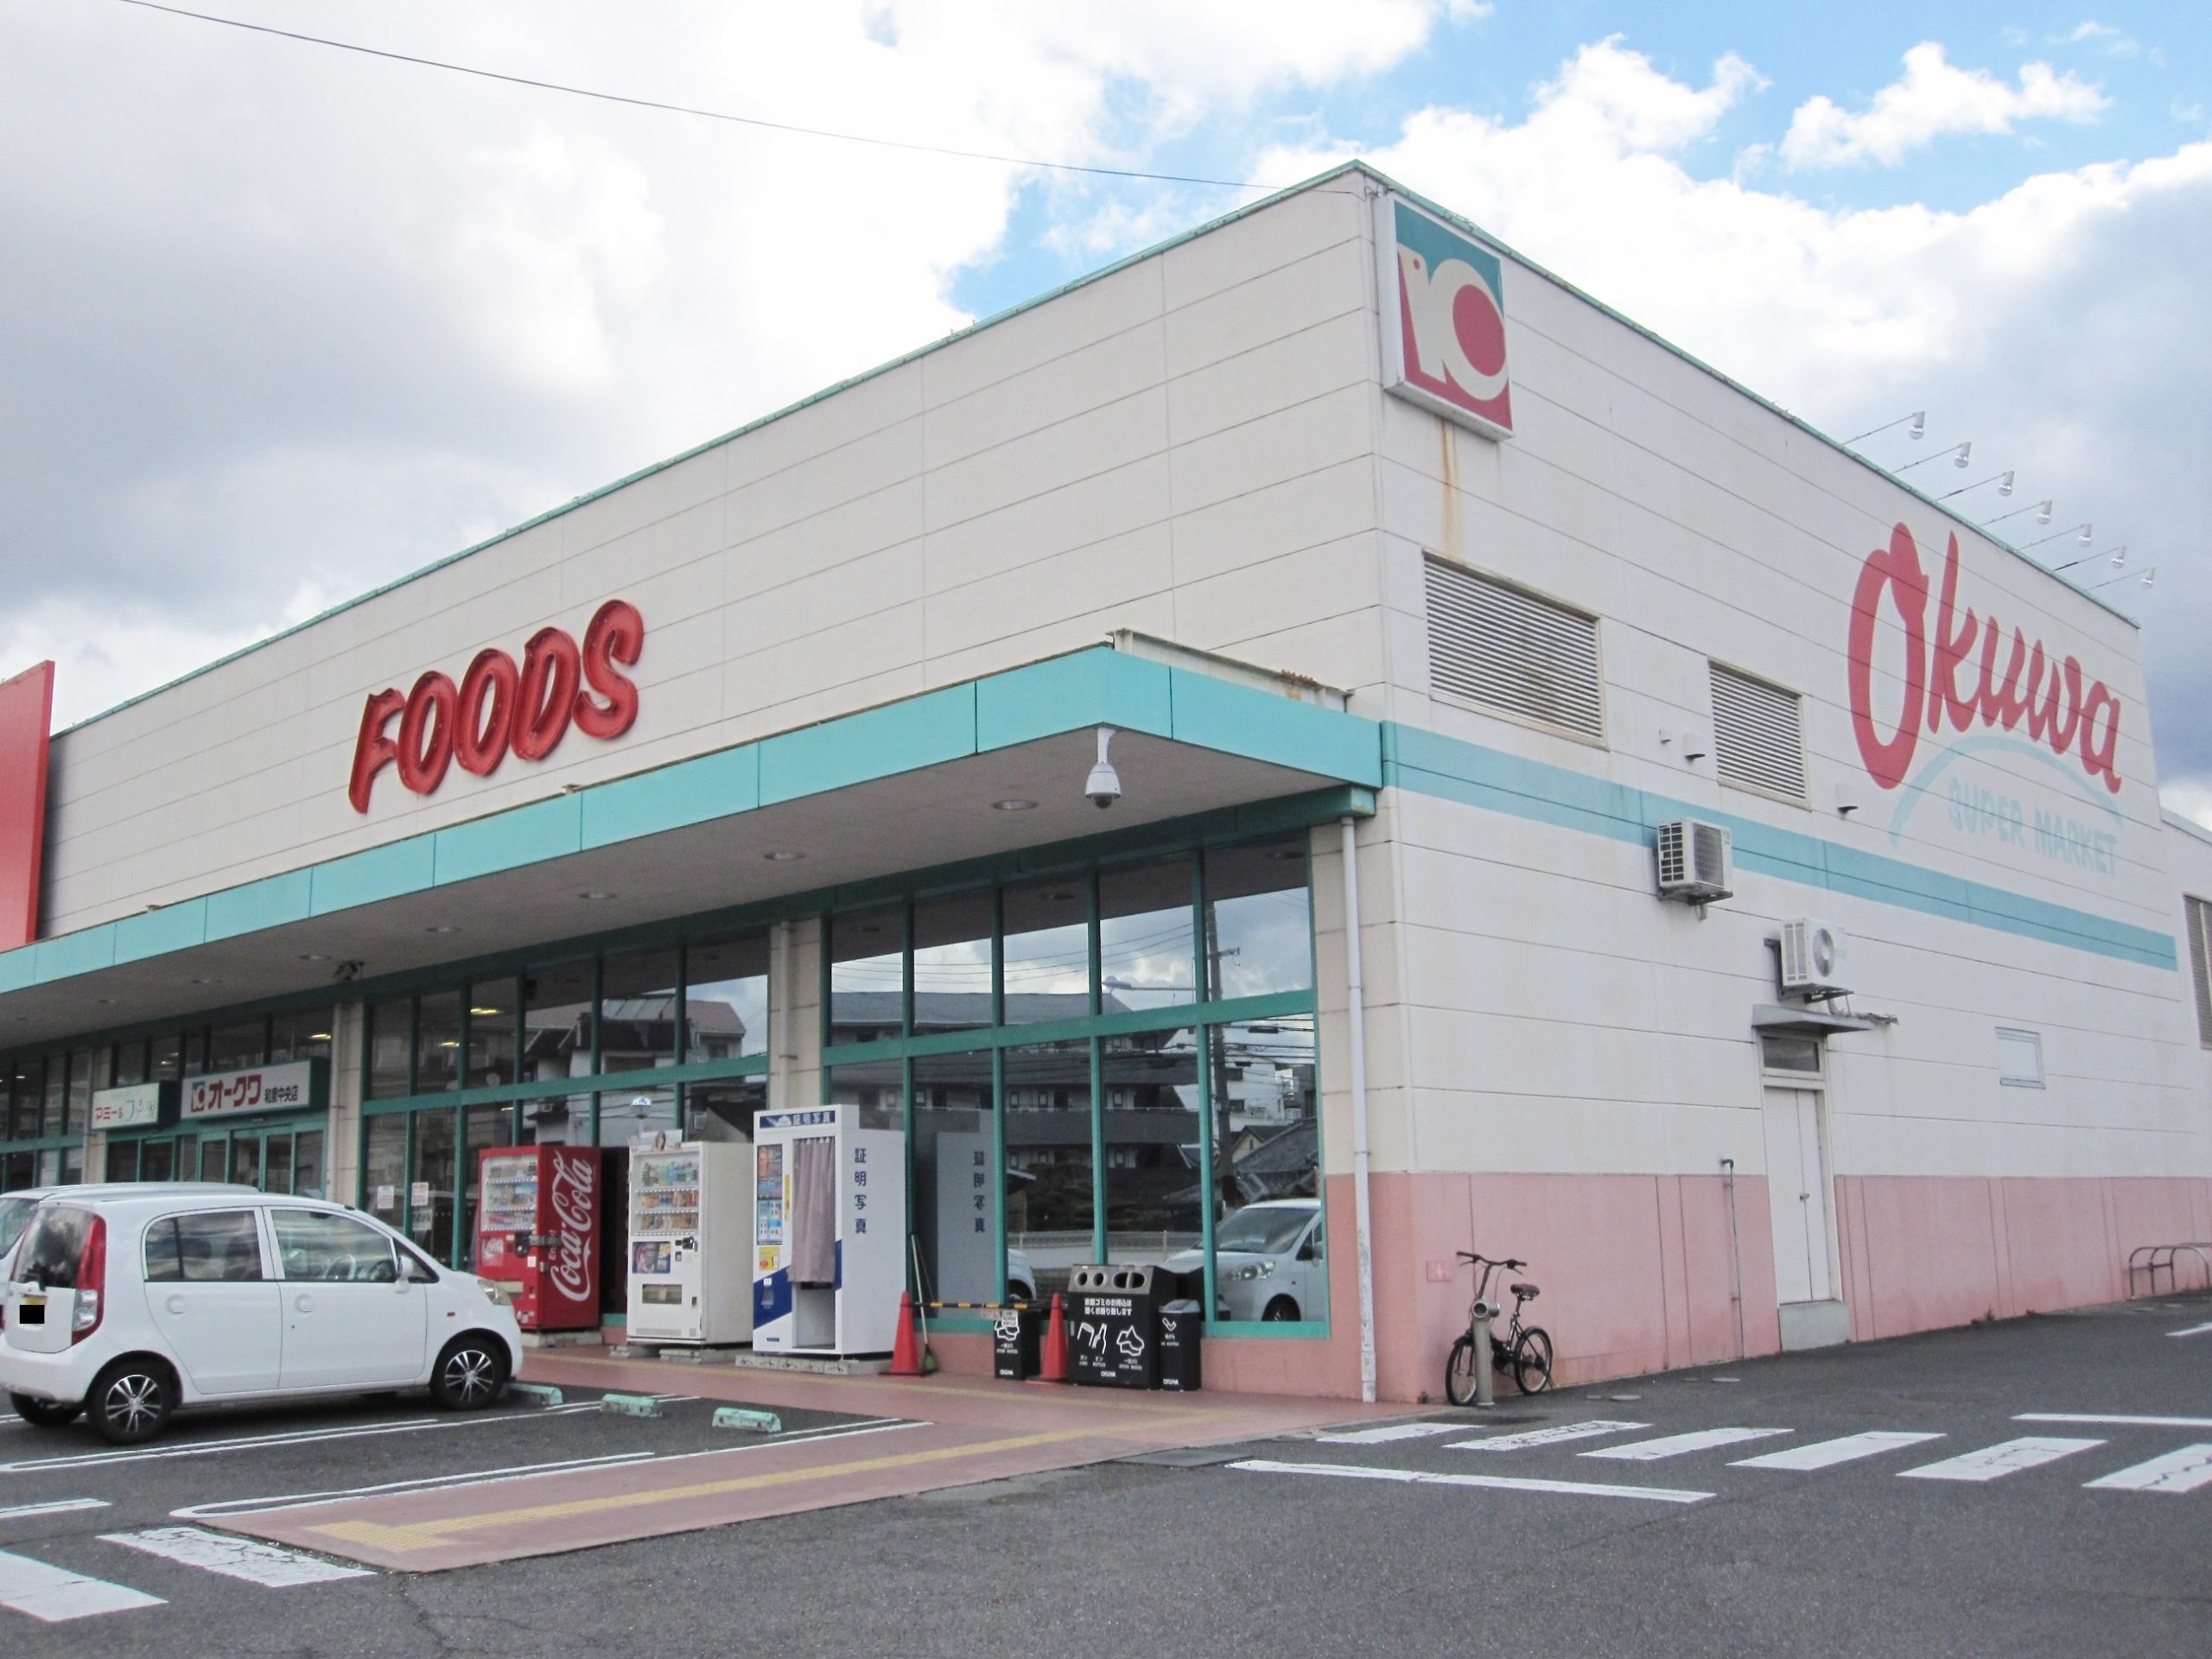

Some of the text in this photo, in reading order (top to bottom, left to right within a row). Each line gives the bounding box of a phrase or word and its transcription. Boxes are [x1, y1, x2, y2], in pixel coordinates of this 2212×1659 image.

[348, 599, 644, 814] FOODS
[1848, 522, 2121, 794] Okuwa
[1948, 777, 2116, 877] SUPER MARKET
[208, 1074, 262, 1109] オークワ
[792, 1112, 830, 1124] 証明写真
[550, 1150, 594, 1301] Coca-Cola
[854, 1147, 867, 1234] 証明写真
